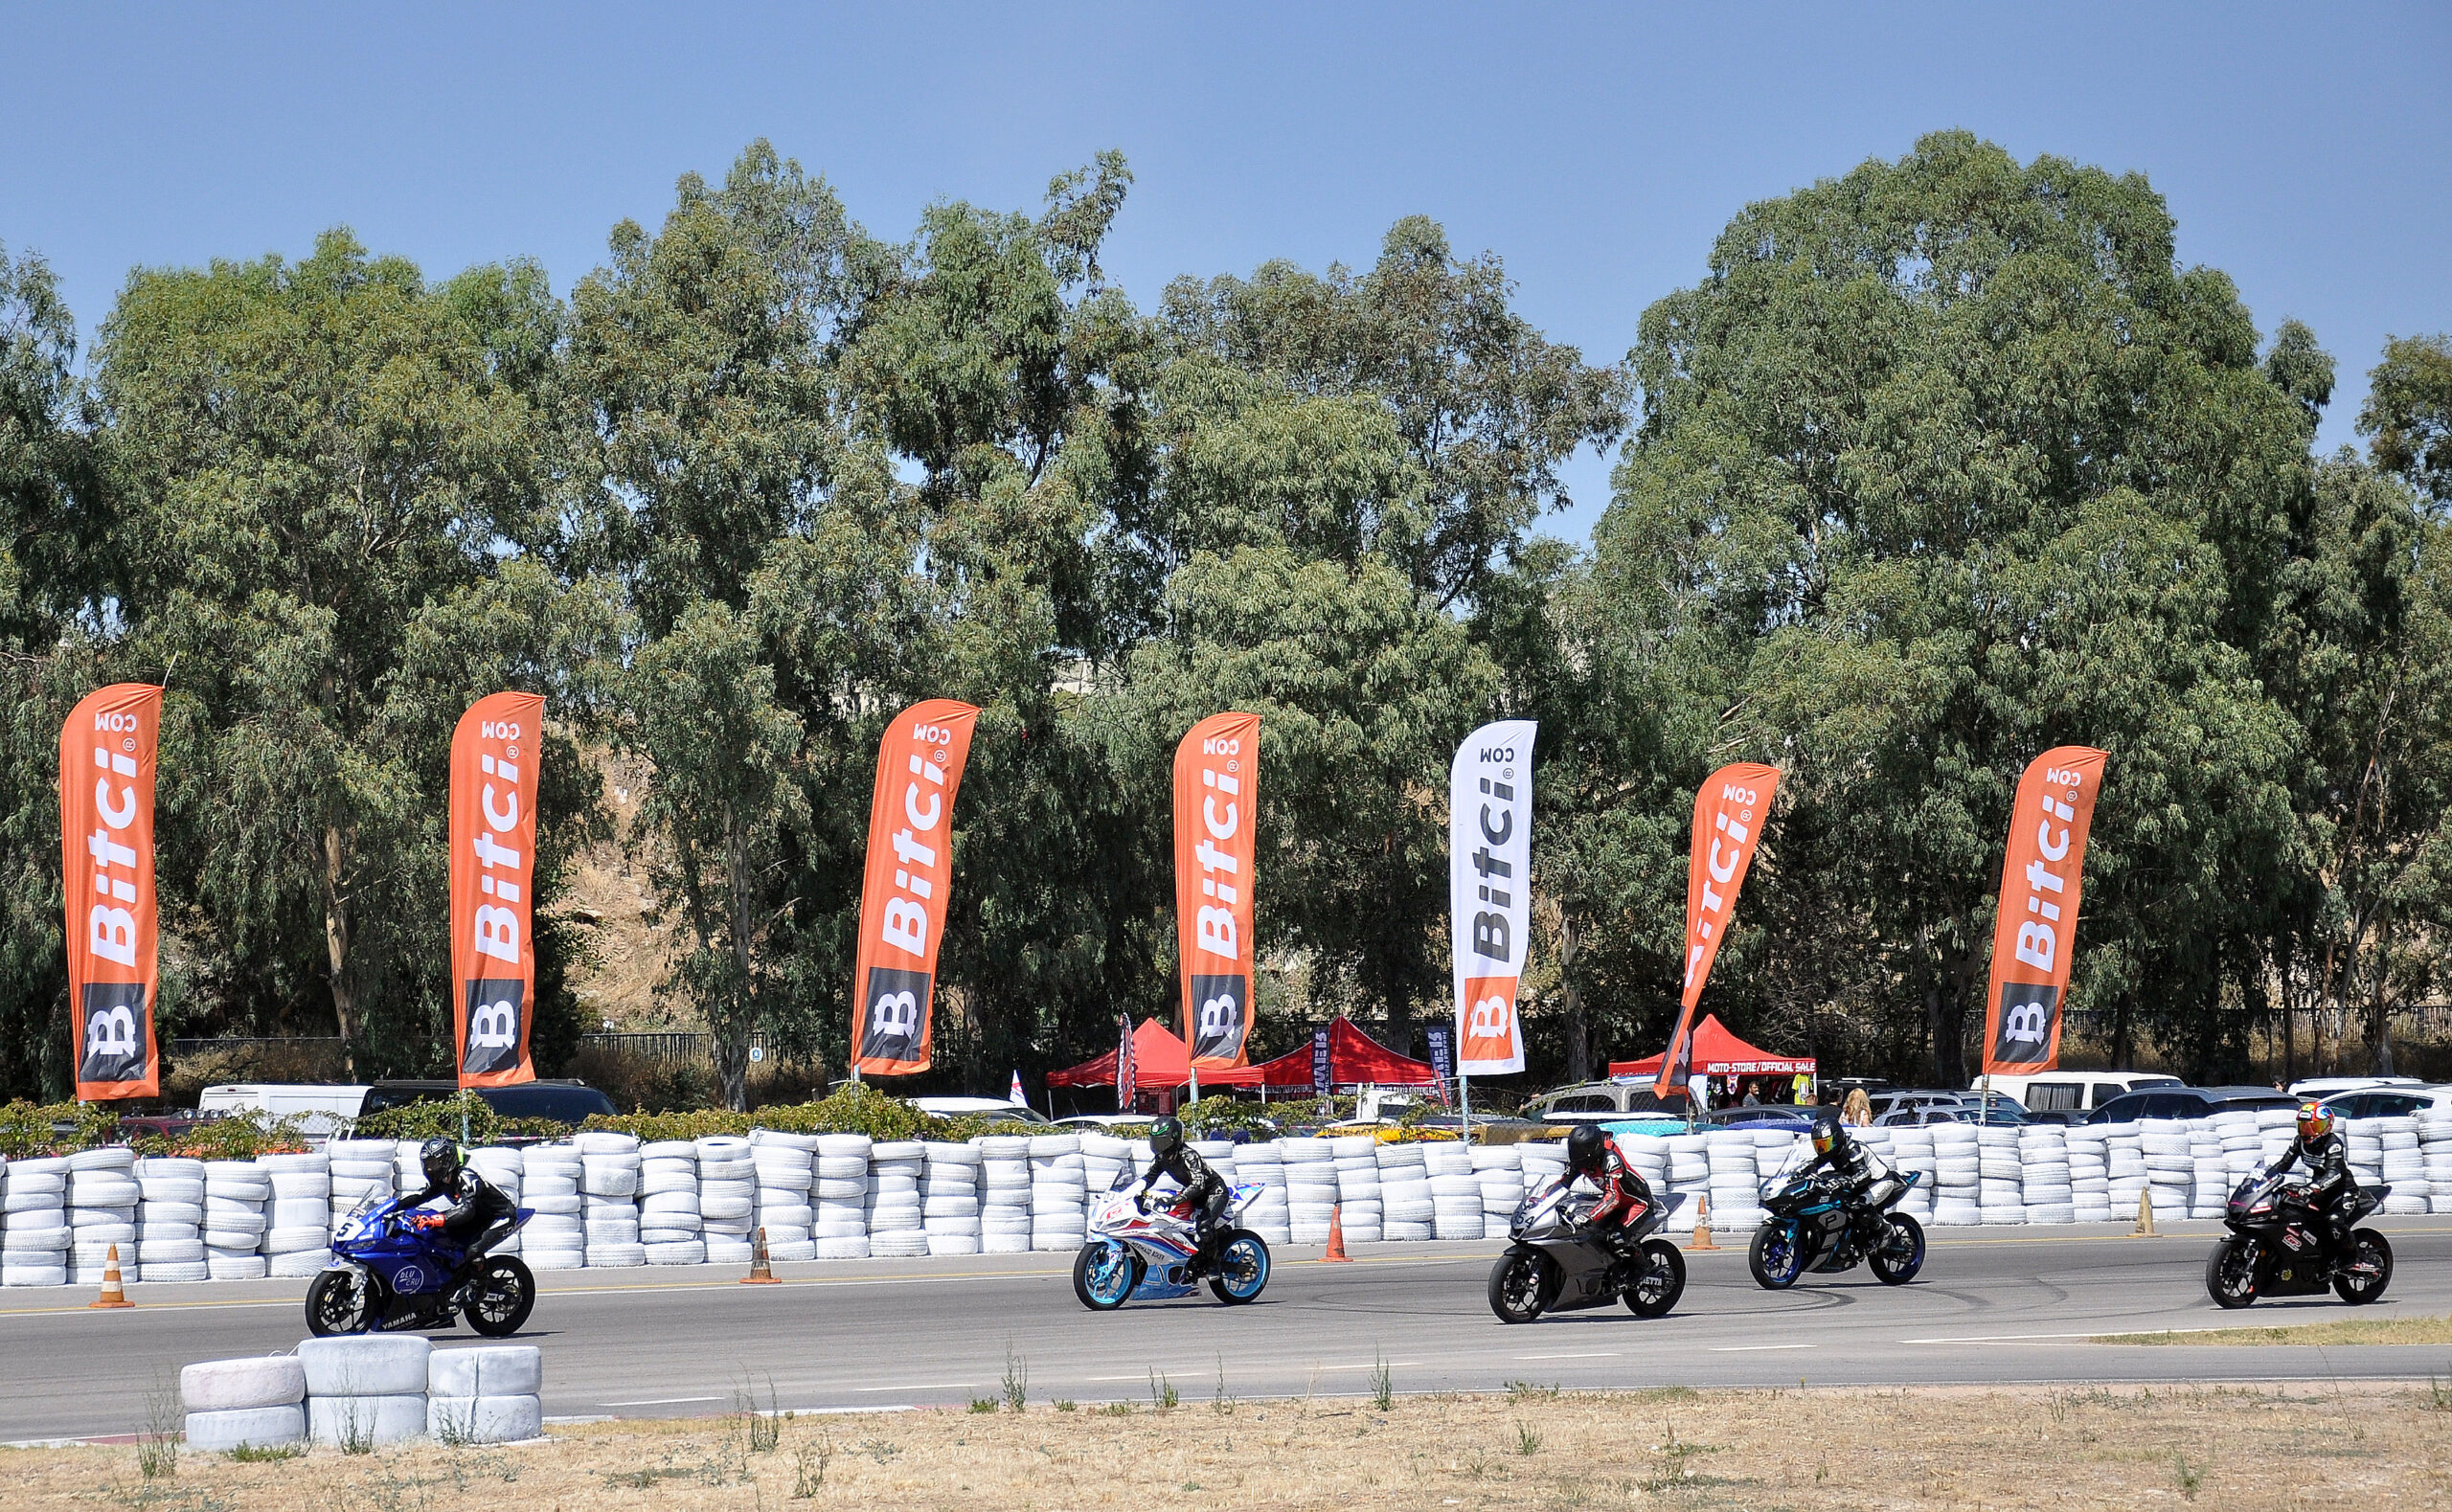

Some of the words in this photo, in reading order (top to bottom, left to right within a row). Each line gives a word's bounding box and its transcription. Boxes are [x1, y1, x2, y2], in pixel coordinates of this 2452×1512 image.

[95, 712, 137, 732] COM
[482, 720, 520, 740] COM
[913, 723, 951, 745] COM
[1203, 738, 1239, 756] COM
[1480, 747, 1514, 763] COM
[2046, 767, 2081, 786] COM
[1722, 783, 1757, 806] COM
[88, 747, 136, 967] Bitci
[473, 753, 520, 964] Bitci
[882, 754, 943, 958] Bitci
[1194, 768, 1239, 960] Bitci
[1471, 777, 1514, 963] Bitci
[2015, 794, 2075, 973] Bitci
[1795, 1062, 1815, 1072] SALE
[382, 1312, 417, 1330] YAMAHA
